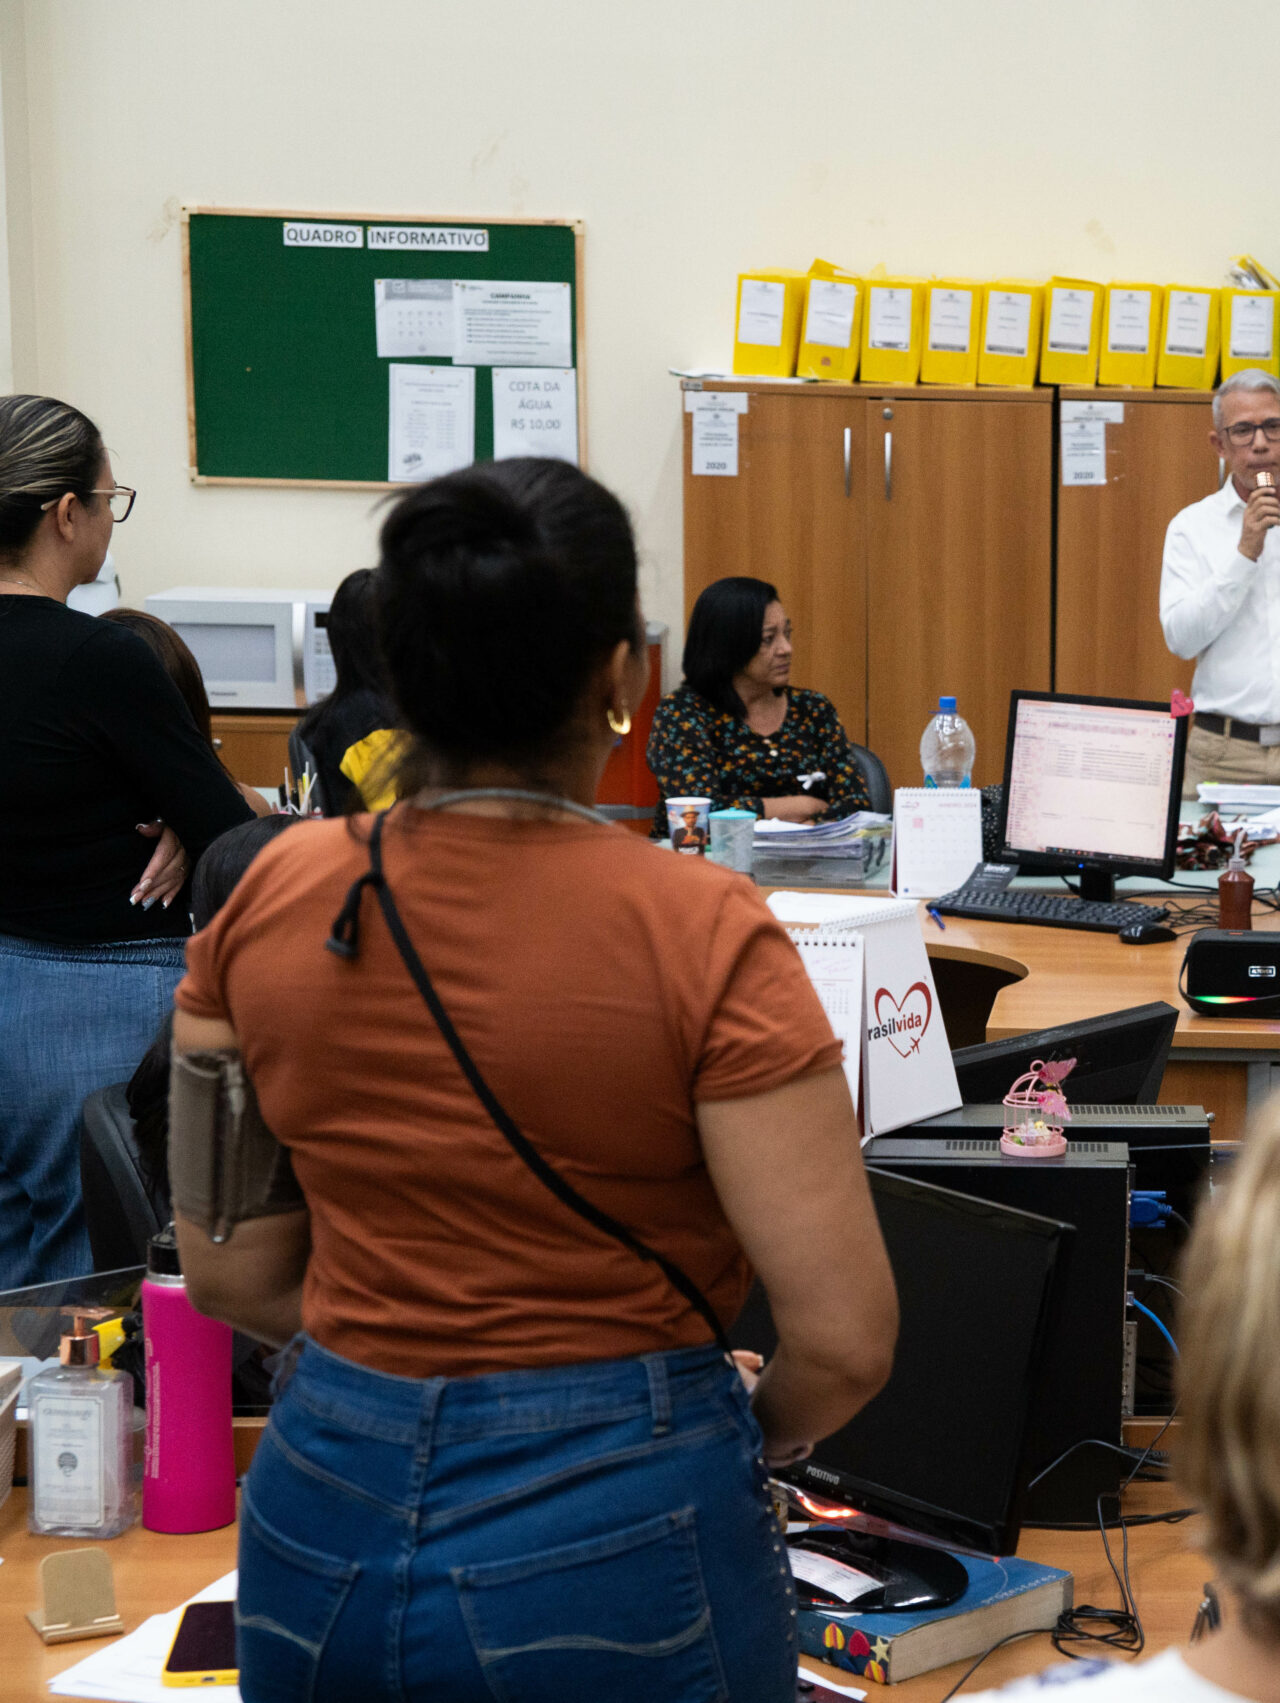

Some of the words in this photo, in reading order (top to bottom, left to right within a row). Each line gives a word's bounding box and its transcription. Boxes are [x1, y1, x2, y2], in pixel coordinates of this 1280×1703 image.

[286, 227, 357, 243] QUADRO
[370, 230, 487, 247] INFORMATIVO
[508, 381, 541, 392] COTA
[543, 382, 561, 392] DA
[518, 398, 552, 410] ÁGUA
[510, 418, 525, 431] R$
[529, 418, 561, 431] 10,00
[705, 461, 728, 470] 2020
[867, 1012, 922, 1041] rasilvida
[806, 1465, 841, 1485] POSITIVO
